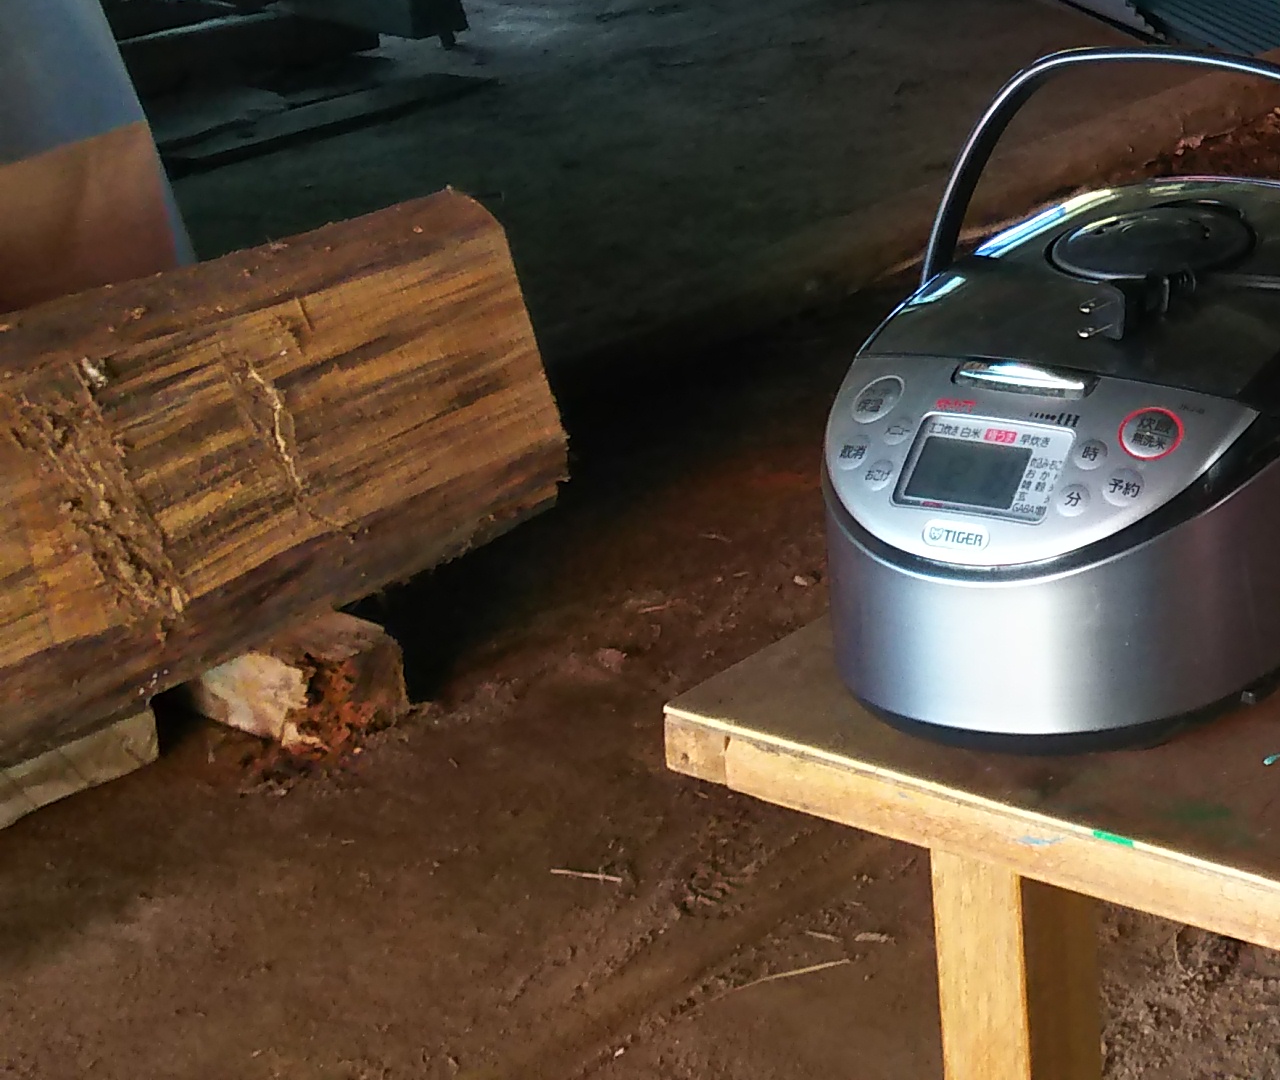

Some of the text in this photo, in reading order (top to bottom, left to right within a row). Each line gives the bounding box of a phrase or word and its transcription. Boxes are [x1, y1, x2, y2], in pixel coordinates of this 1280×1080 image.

[960, 425, 982, 439] 白米
[1019, 433, 1051, 448] 早炊き
[1131, 432, 1166, 450] 無洗米
[839, 445, 868, 460] 取消
[1081, 446, 1099, 462] 時
[1108, 478, 1140, 498] 予約
[1064, 491, 1081, 507] 分
[944, 529, 983, 547] TIGER
